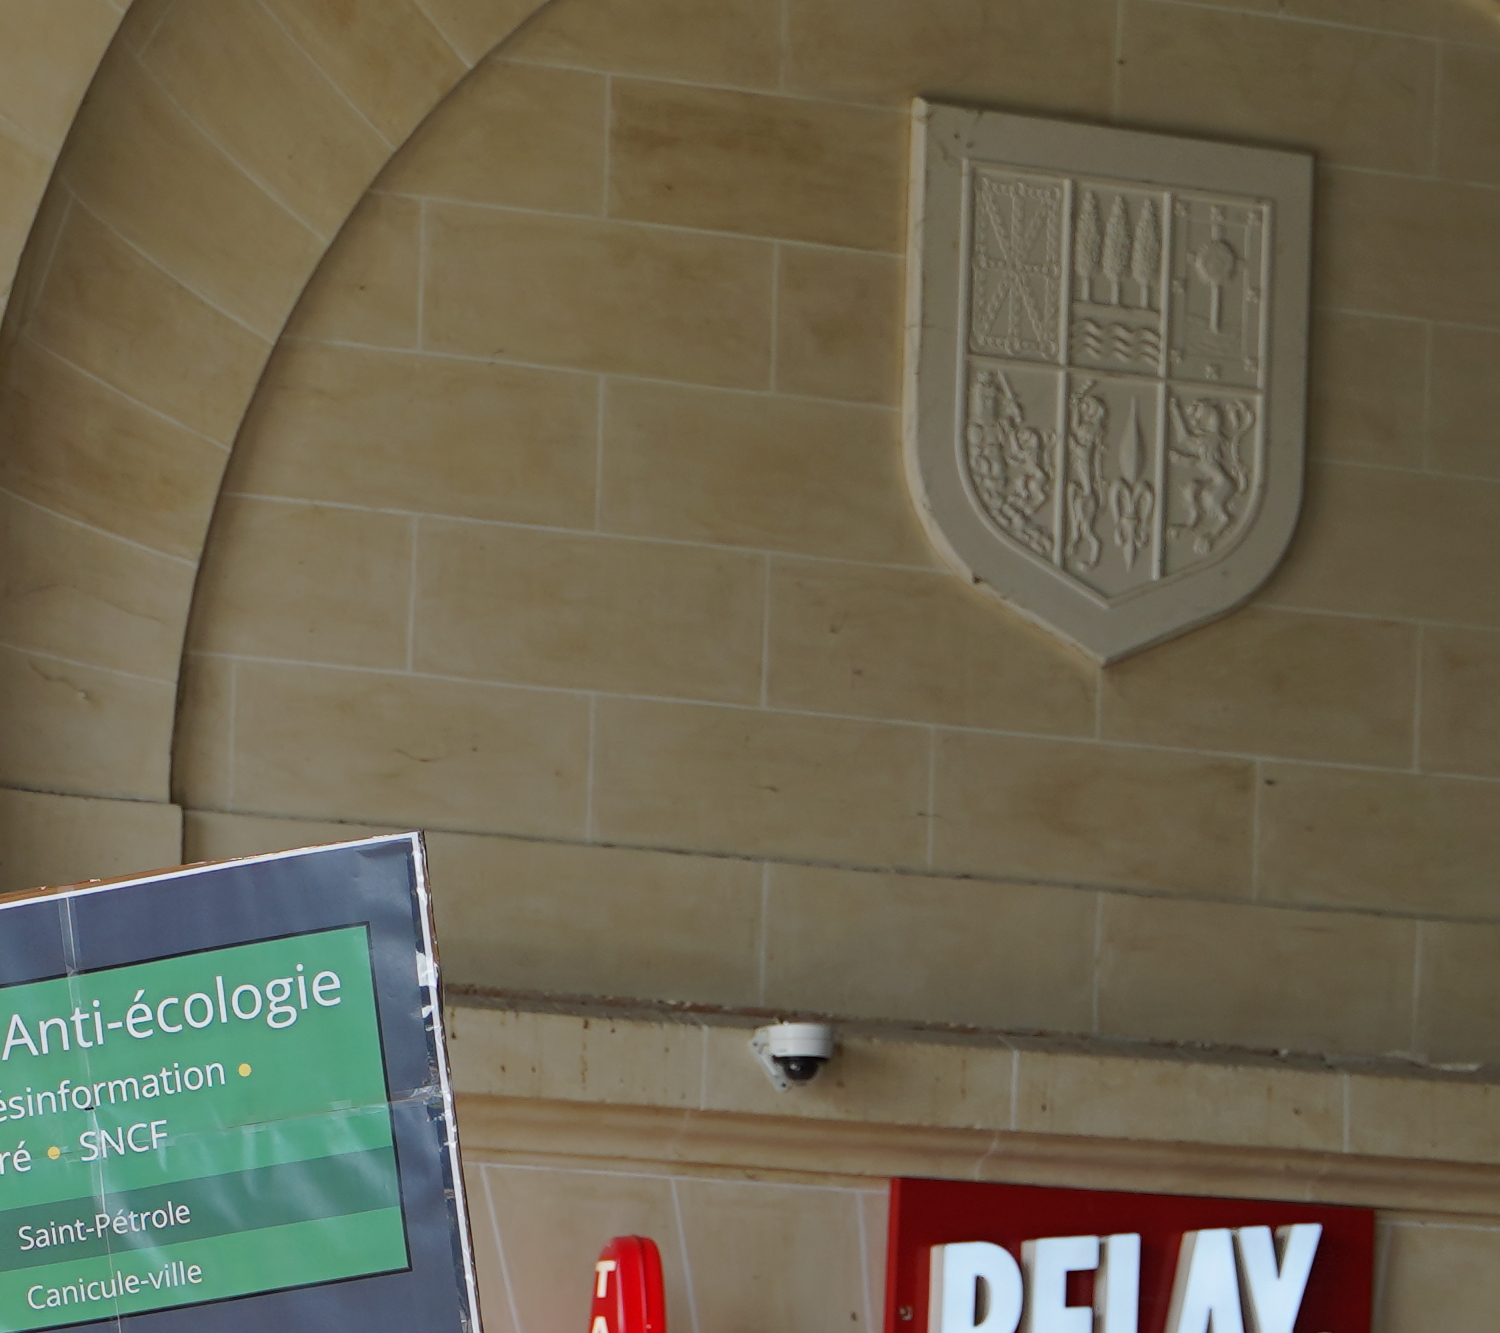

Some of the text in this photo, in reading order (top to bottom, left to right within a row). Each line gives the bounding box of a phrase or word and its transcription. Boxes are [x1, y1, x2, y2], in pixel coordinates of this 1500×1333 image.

[1, 963, 343, 1062] Anti-écologie
[78, 1119, 169, 1164] SNCF
[17, 1201, 191, 1251] Saint-Pétrole
[27, 1260, 203, 1310] Canicule-ville
